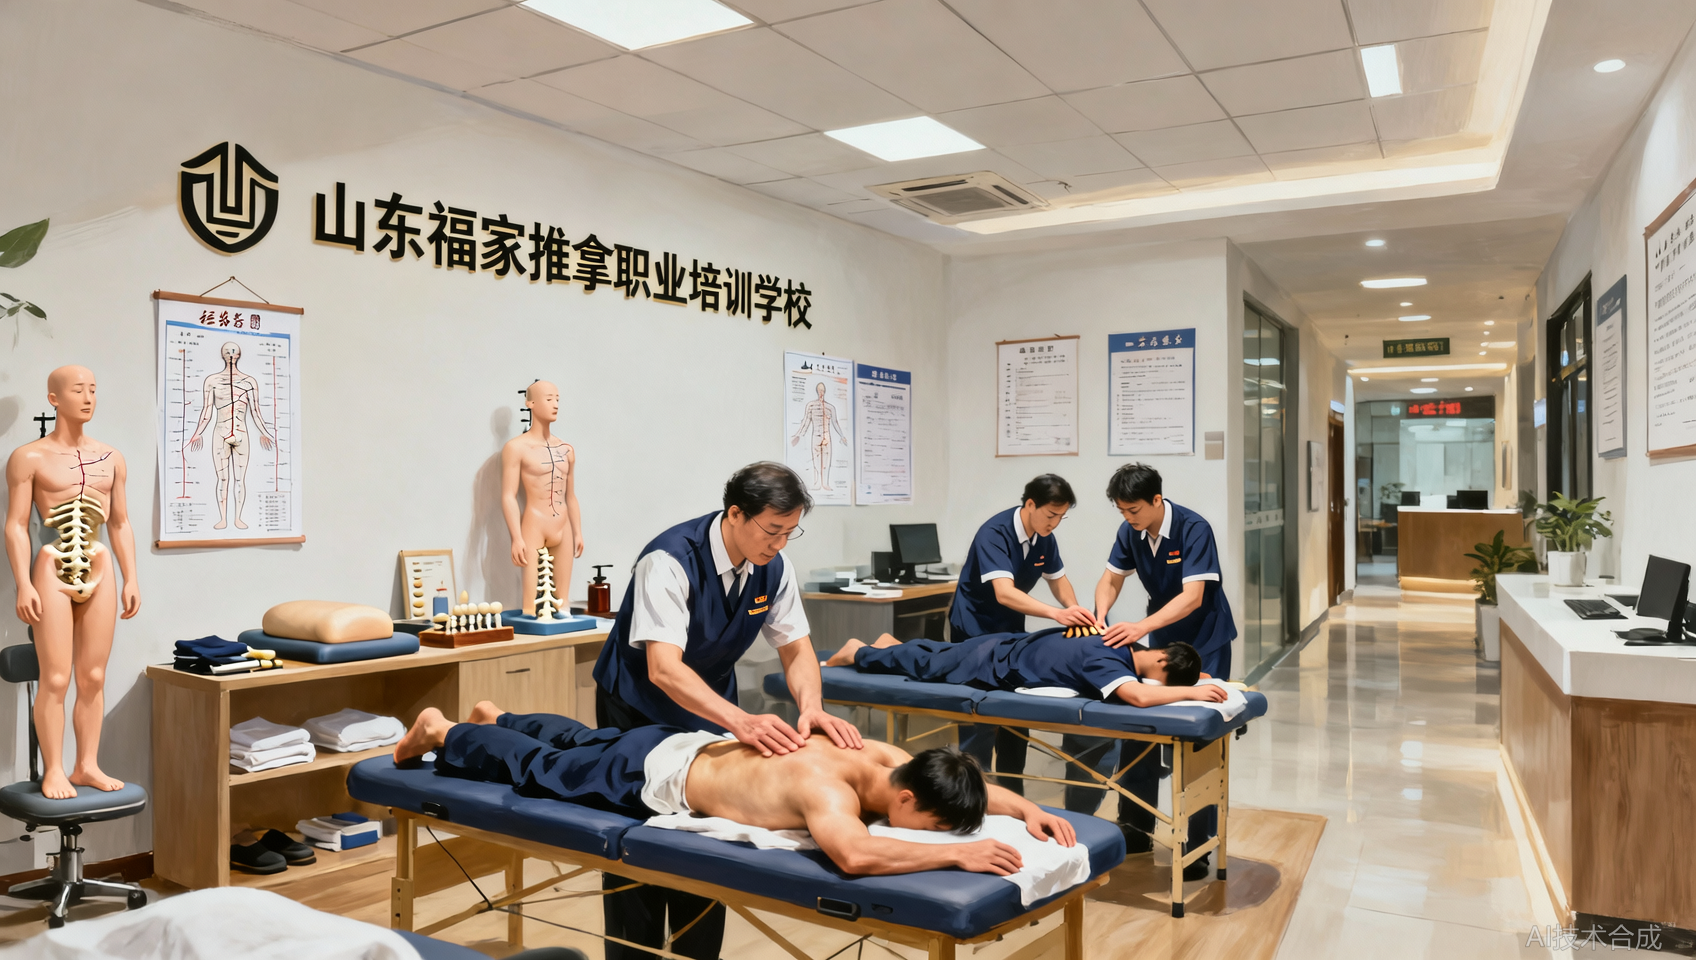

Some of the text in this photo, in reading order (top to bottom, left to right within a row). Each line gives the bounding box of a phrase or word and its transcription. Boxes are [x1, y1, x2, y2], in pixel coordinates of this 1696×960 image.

[314, 182, 812, 330] 山东福家推拿职业培训学校
